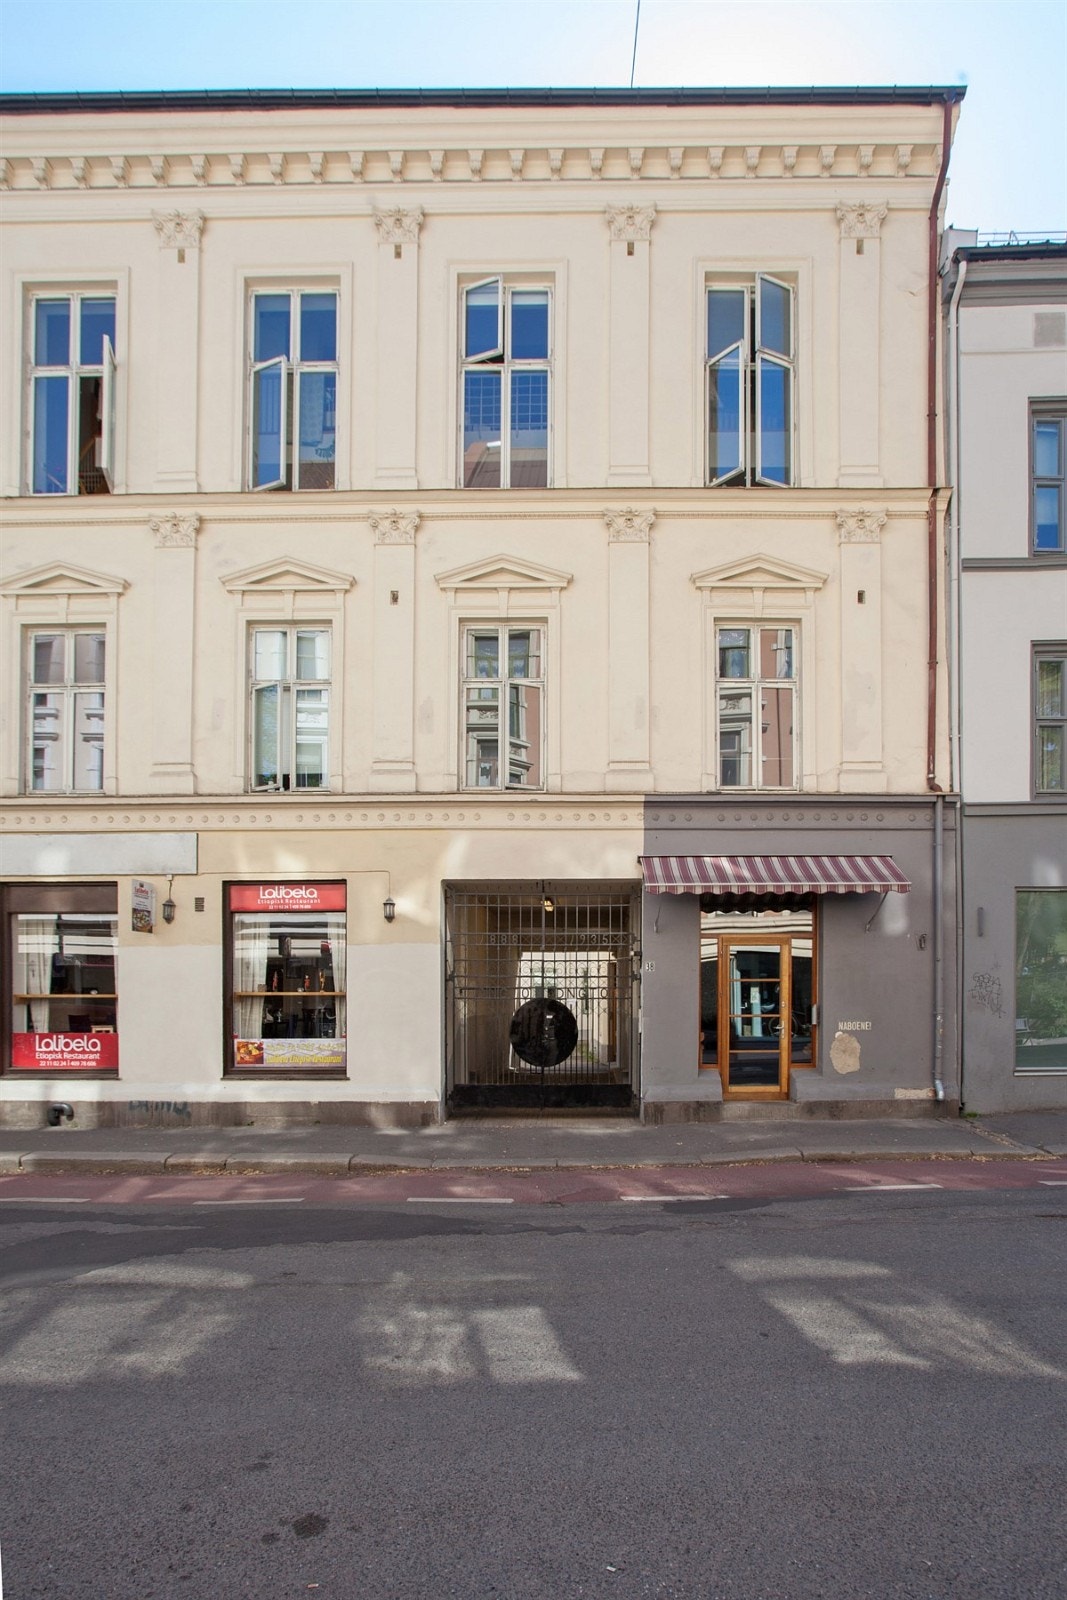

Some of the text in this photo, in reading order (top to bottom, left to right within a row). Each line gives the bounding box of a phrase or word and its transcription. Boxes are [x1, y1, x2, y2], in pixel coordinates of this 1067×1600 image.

[259, 886, 318, 899] Lalibela
[35, 1034, 101, 1052] Lalibela
[35, 1052, 100, 1060] Etiopisk Restaurant
